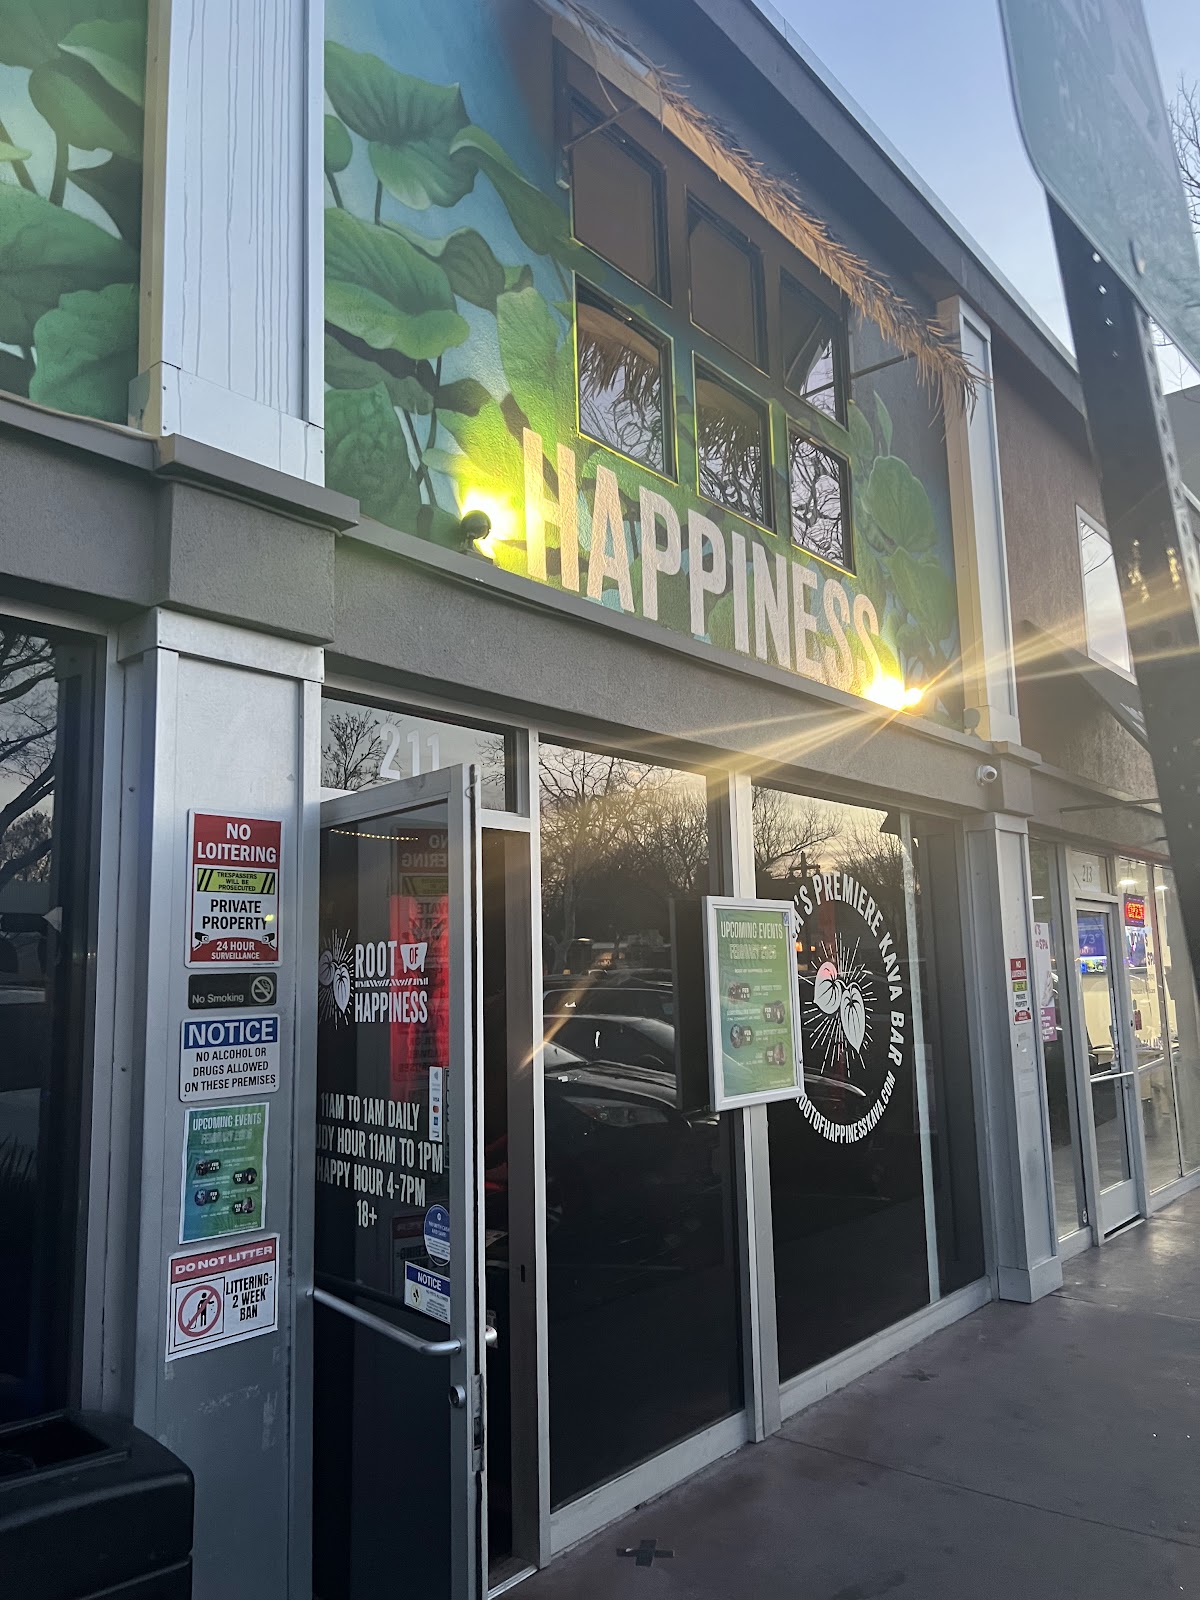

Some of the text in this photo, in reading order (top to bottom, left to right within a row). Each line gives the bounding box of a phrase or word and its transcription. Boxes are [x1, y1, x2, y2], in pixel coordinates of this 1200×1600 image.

[523, 427, 882, 693] HAPPINESS
[379, 722, 440, 780] 211
[226, 823, 251, 840] NO
[198, 842, 276, 863] LOITERING
[217, 871, 257, 879] TRESPASSERS
[210, 899, 261, 913] PRIVATE
[812, 871, 884, 938] PREMIERE
[202, 916, 267, 930] PROPERTY
[720, 921, 783, 939] UPCOMING EVENTS
[211, 952, 260, 960] SURVEILLANCE
[216, 941, 255, 950] 24 HOUR
[355, 941, 418, 978] ROOT OF
[879, 932, 903, 1001] KAVA
[192, 993, 244, 1003] No Smoking
[354, 991, 428, 1023] HAPPINESS
[188, 1020, 274, 1046] NOTICE
[888, 1011, 905, 1067] BAR
[196, 1047, 266, 1062] NO ALCOHOL OR
[193, 1061, 268, 1077] DRUGS ALLOWED
[185, 1074, 276, 1092] ON THESE PREMISES
[321, 1092, 420, 1131] 11AM TO 1AM DAILY
[796, 1070, 896, 1144] OOTOFHAPPINESSKAVA.COM
[193, 1112, 261, 1131] UPCOMING EVENTS
[337, 1127, 366, 1158] HOUR
[369, 1132, 396, 1164] 11AM
[399, 1137, 415, 1168] TO
[418, 1141, 443, 1174] 1PM
[317, 1156, 426, 1207] HAPPY HOUR 4-7PM
[357, 1199, 378, 1228] 18+
[175, 1246, 273, 1275] DO NOT LITTER
[225, 1272, 273, 1295] LITTERING=
[417, 1271, 442, 1291] NOTICE
[232, 1288, 266, 1308] 2 WEEK
[240, 1304, 258, 1321] BAN
